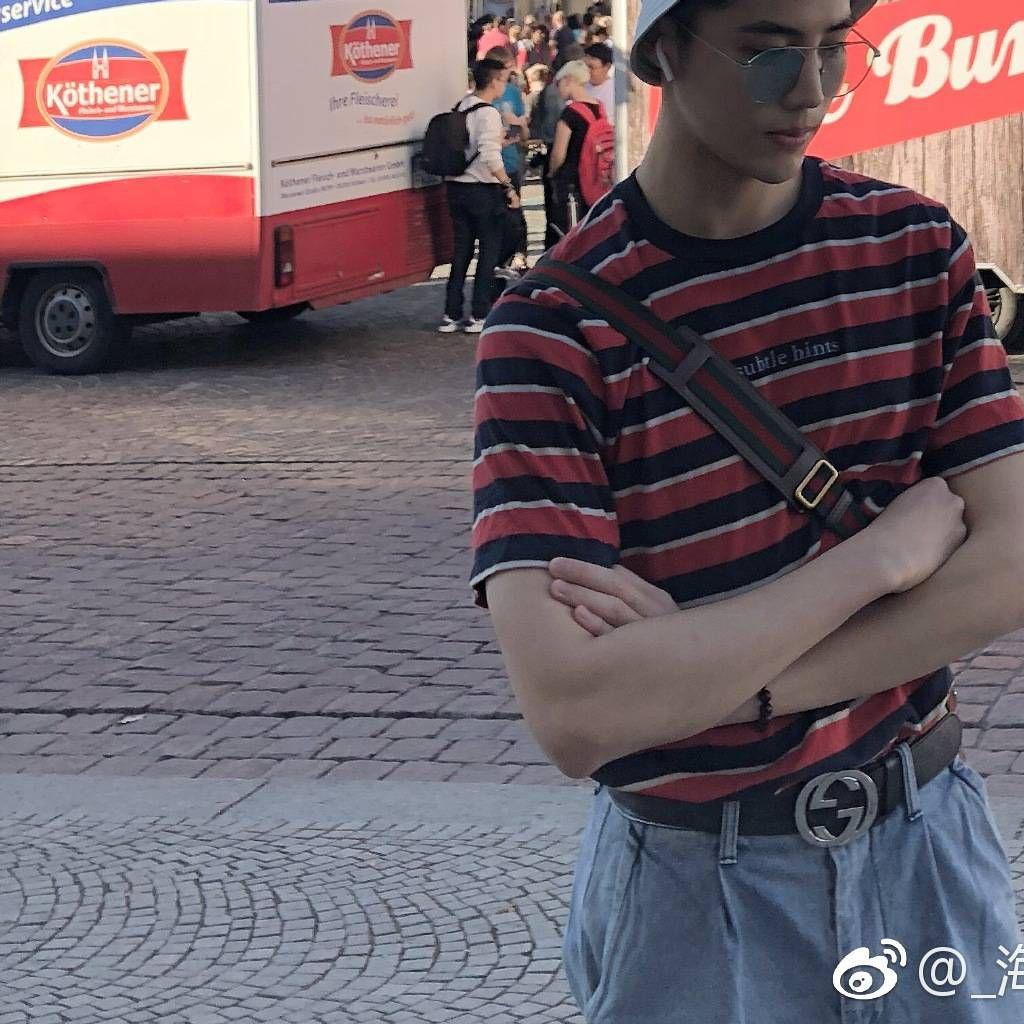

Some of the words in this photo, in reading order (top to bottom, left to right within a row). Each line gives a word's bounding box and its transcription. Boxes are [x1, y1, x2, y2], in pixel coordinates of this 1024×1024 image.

[344, 41, 400, 66] Köthener
[46, 81, 161, 116] Köthener
[792, 340, 840, 362] hints
